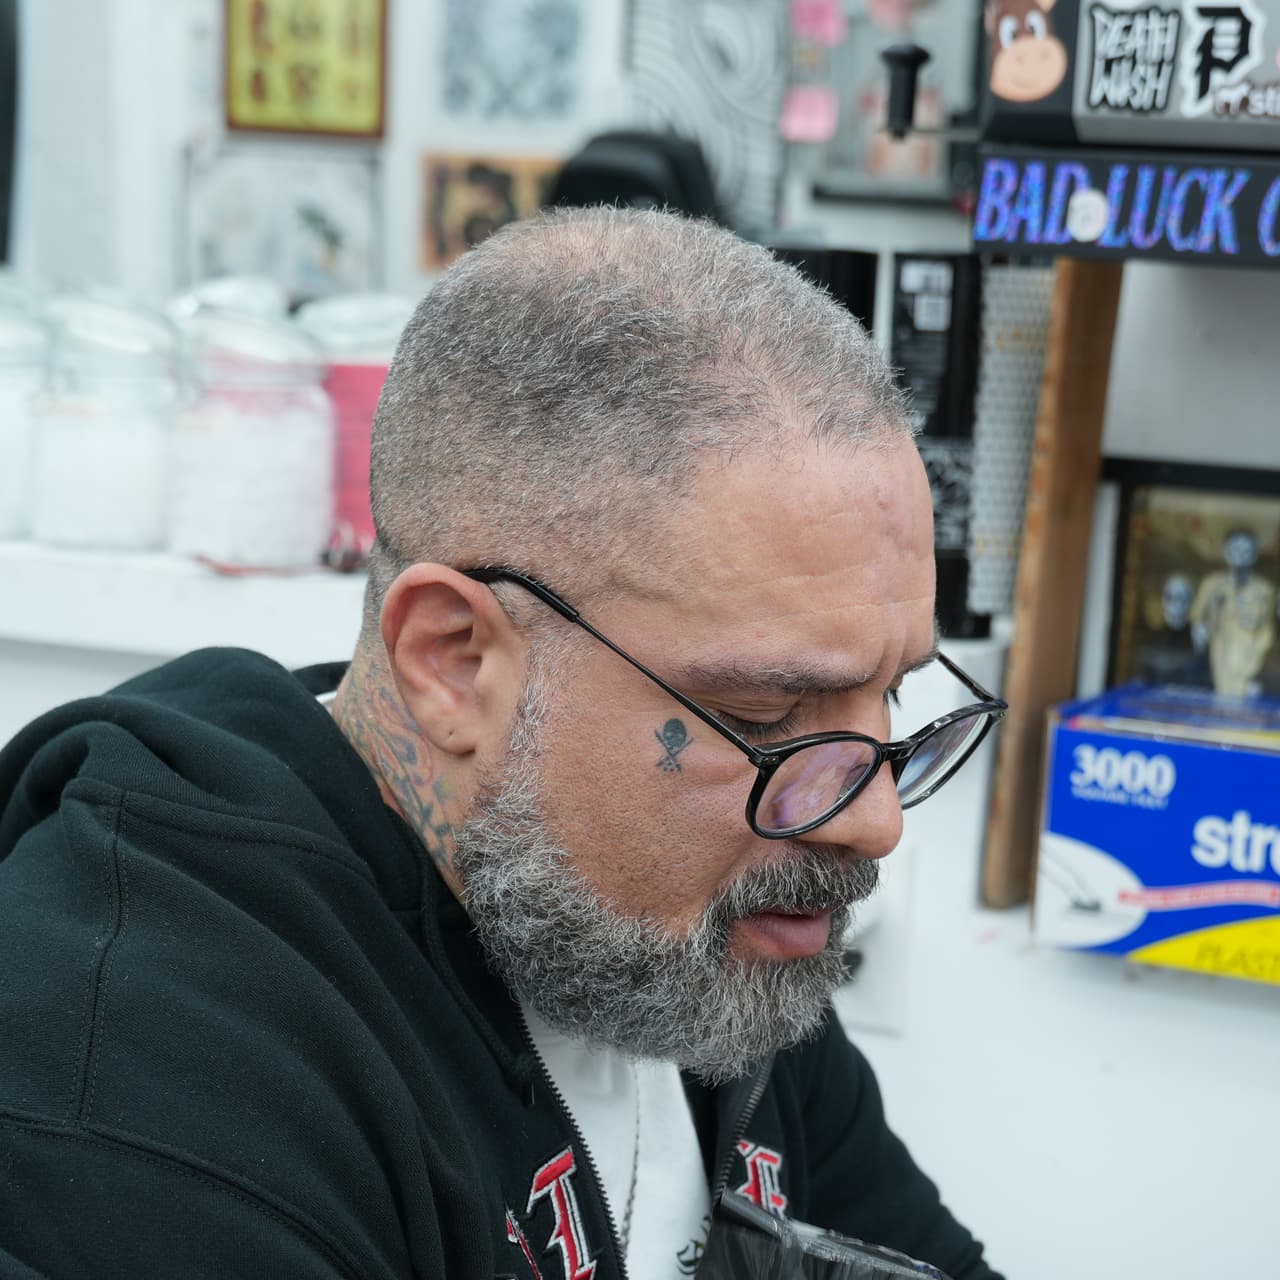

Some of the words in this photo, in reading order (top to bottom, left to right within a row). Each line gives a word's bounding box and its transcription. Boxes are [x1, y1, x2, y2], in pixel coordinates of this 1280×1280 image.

[1090, 5, 1179, 62] DEATH
[1089, 57, 1173, 110] WASH
[973, 157, 1091, 243] BAD
[1098, 162, 1250, 256] LUCK
[1069, 743, 1177, 799] 3000
